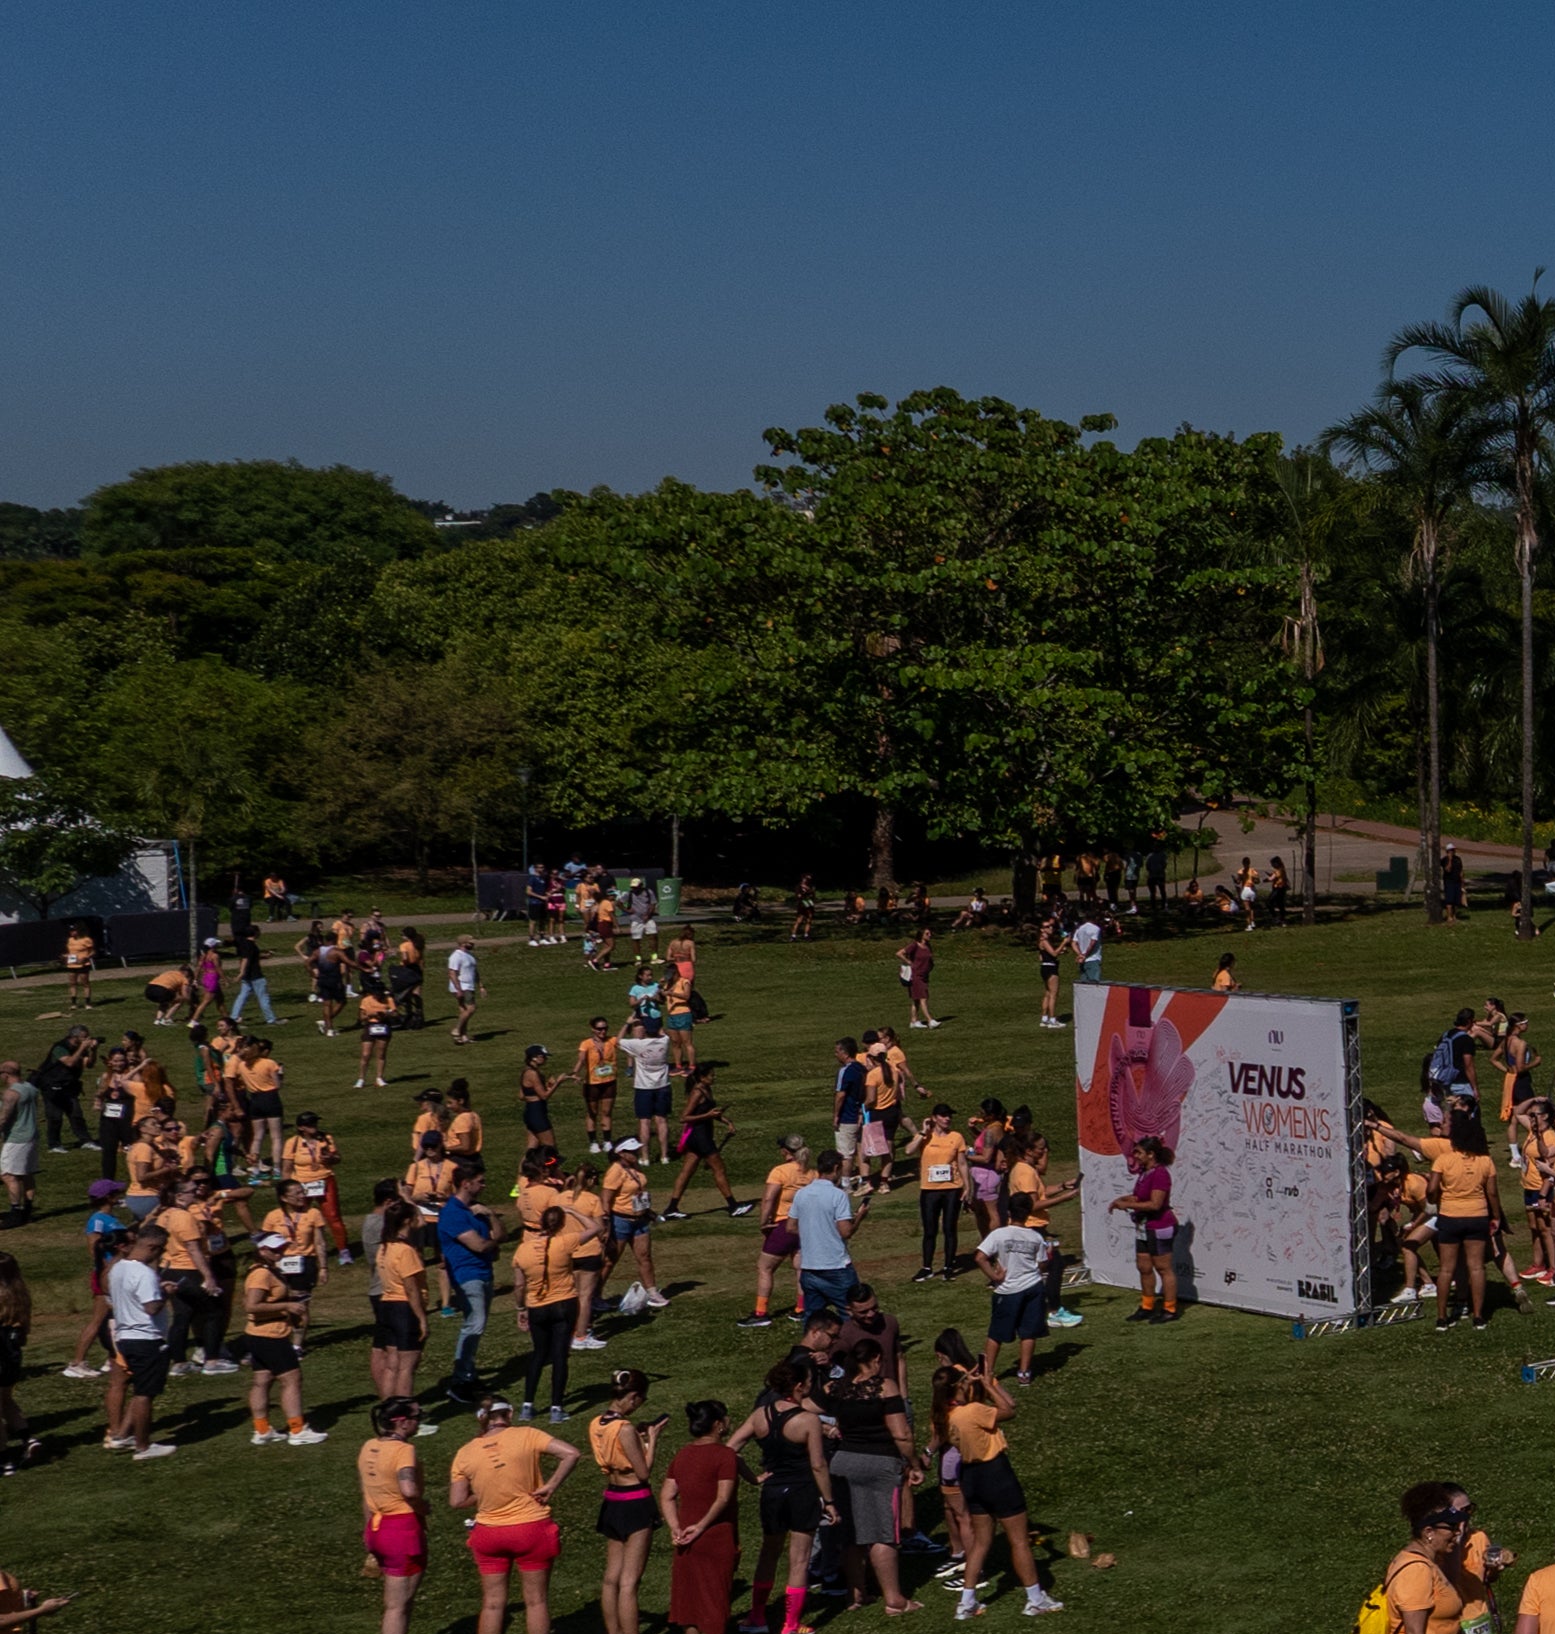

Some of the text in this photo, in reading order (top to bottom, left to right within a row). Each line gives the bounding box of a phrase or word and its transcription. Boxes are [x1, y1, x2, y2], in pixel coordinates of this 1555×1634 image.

[1228, 1061, 1306, 1100] VENUS
[1243, 1100, 1331, 1142] WOMEN'S
[1245, 1138, 1332, 1160] HALF MARATHON
[1297, 1279, 1339, 1304] BRASIL
